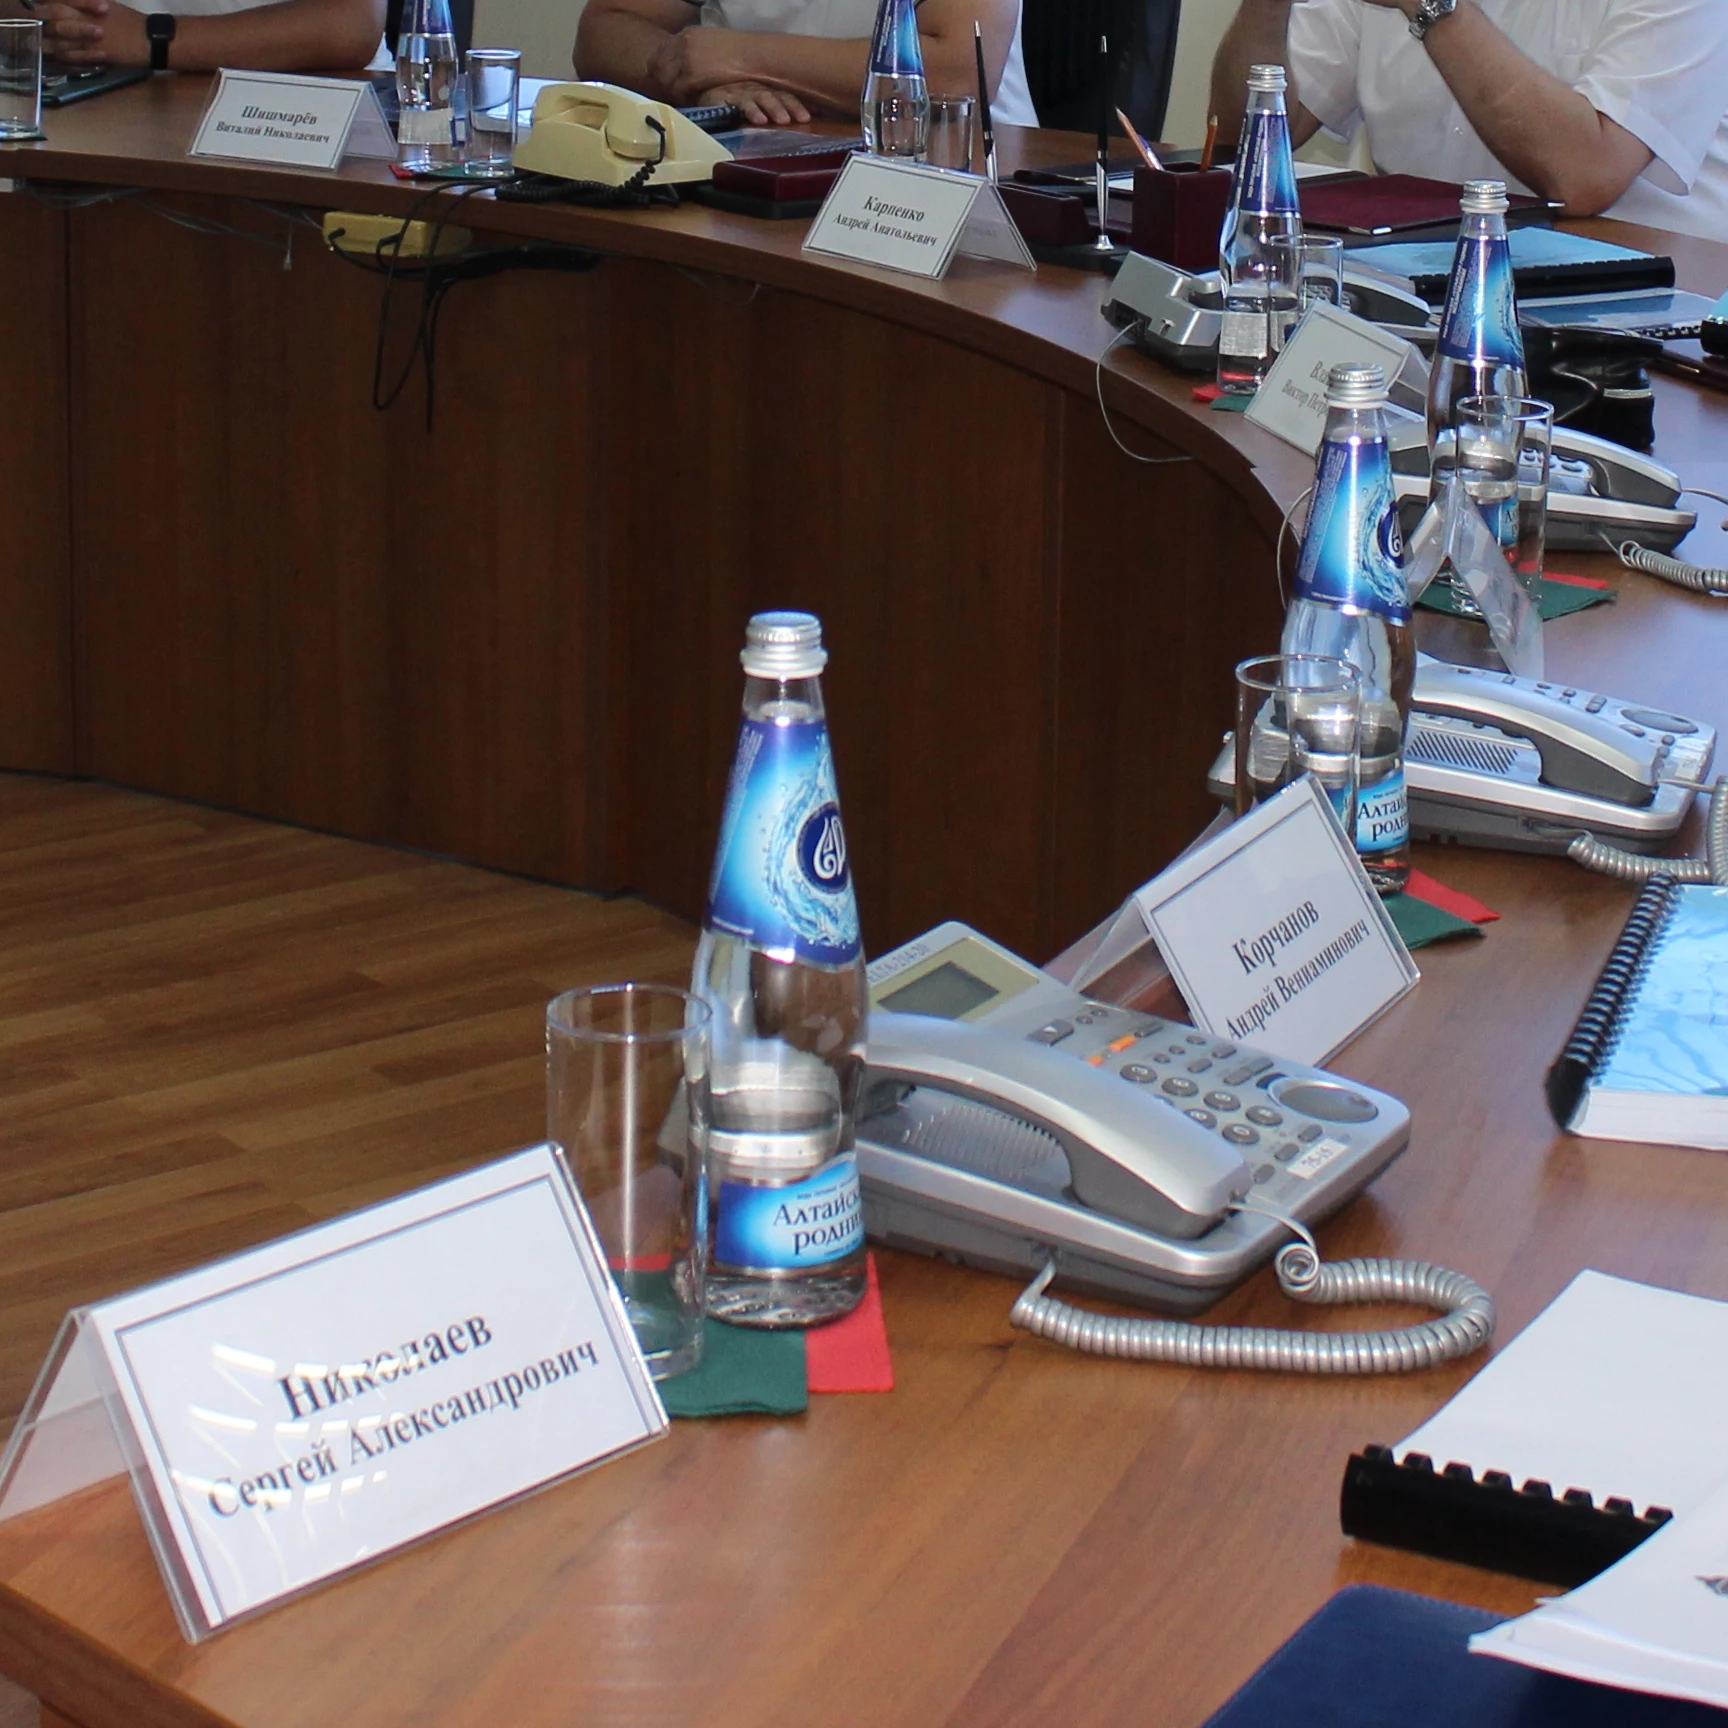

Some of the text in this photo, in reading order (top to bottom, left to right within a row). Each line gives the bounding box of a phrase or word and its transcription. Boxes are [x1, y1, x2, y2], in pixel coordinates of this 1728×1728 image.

[215, 121, 330, 144] Виталий Николаевич
[241, 105, 318, 127] Шишмарёв
[863, 195, 925, 222] Карпенко
[833, 212, 938, 247] Андрей Анатольевич
[1281, 379, 1329, 419] Виктор Петр
[1232, 900, 1320, 975] Корчанов
[1225, 984, 1281, 1040] Андрей
[278, 1314, 493, 1421] Николаев
[207, 1339, 600, 1520] Сергей Александрович
